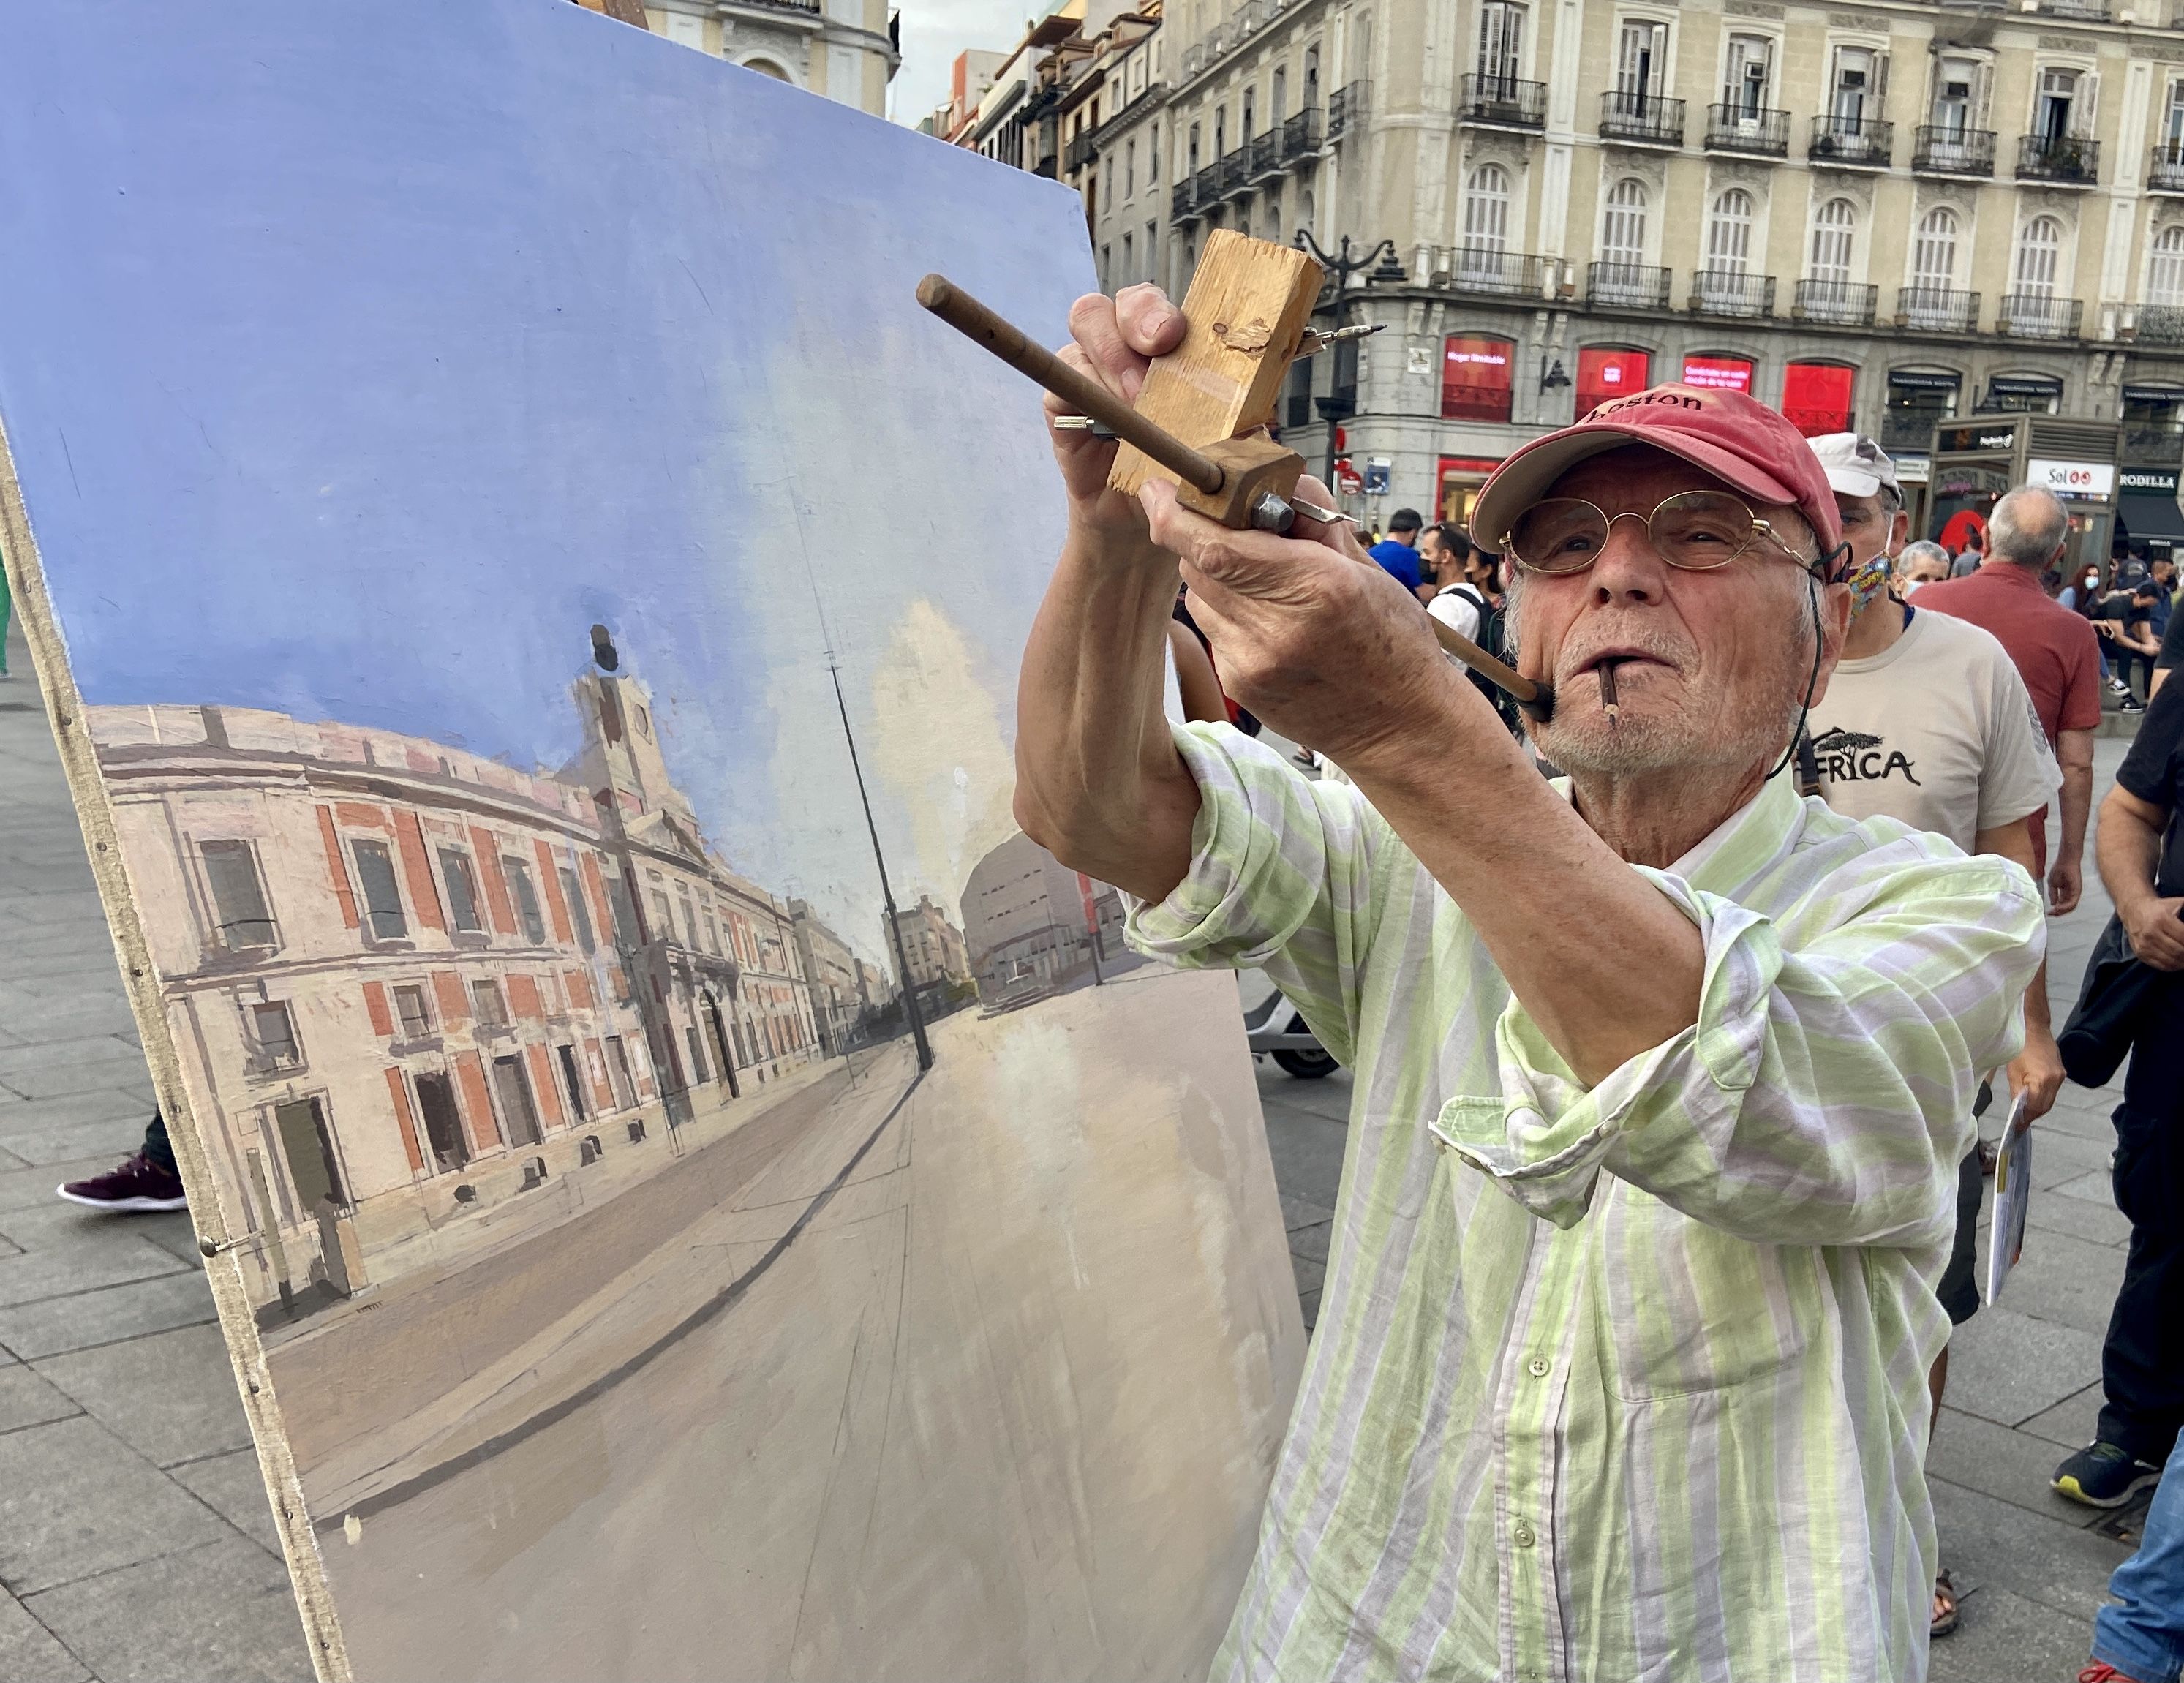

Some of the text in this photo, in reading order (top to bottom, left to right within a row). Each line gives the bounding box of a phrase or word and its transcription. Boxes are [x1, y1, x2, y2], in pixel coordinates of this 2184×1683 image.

[2049, 467, 2067, 484] Sol
[2119, 474, 2174, 489] RODILLA
[1815, 740, 1921, 786] FRICA
